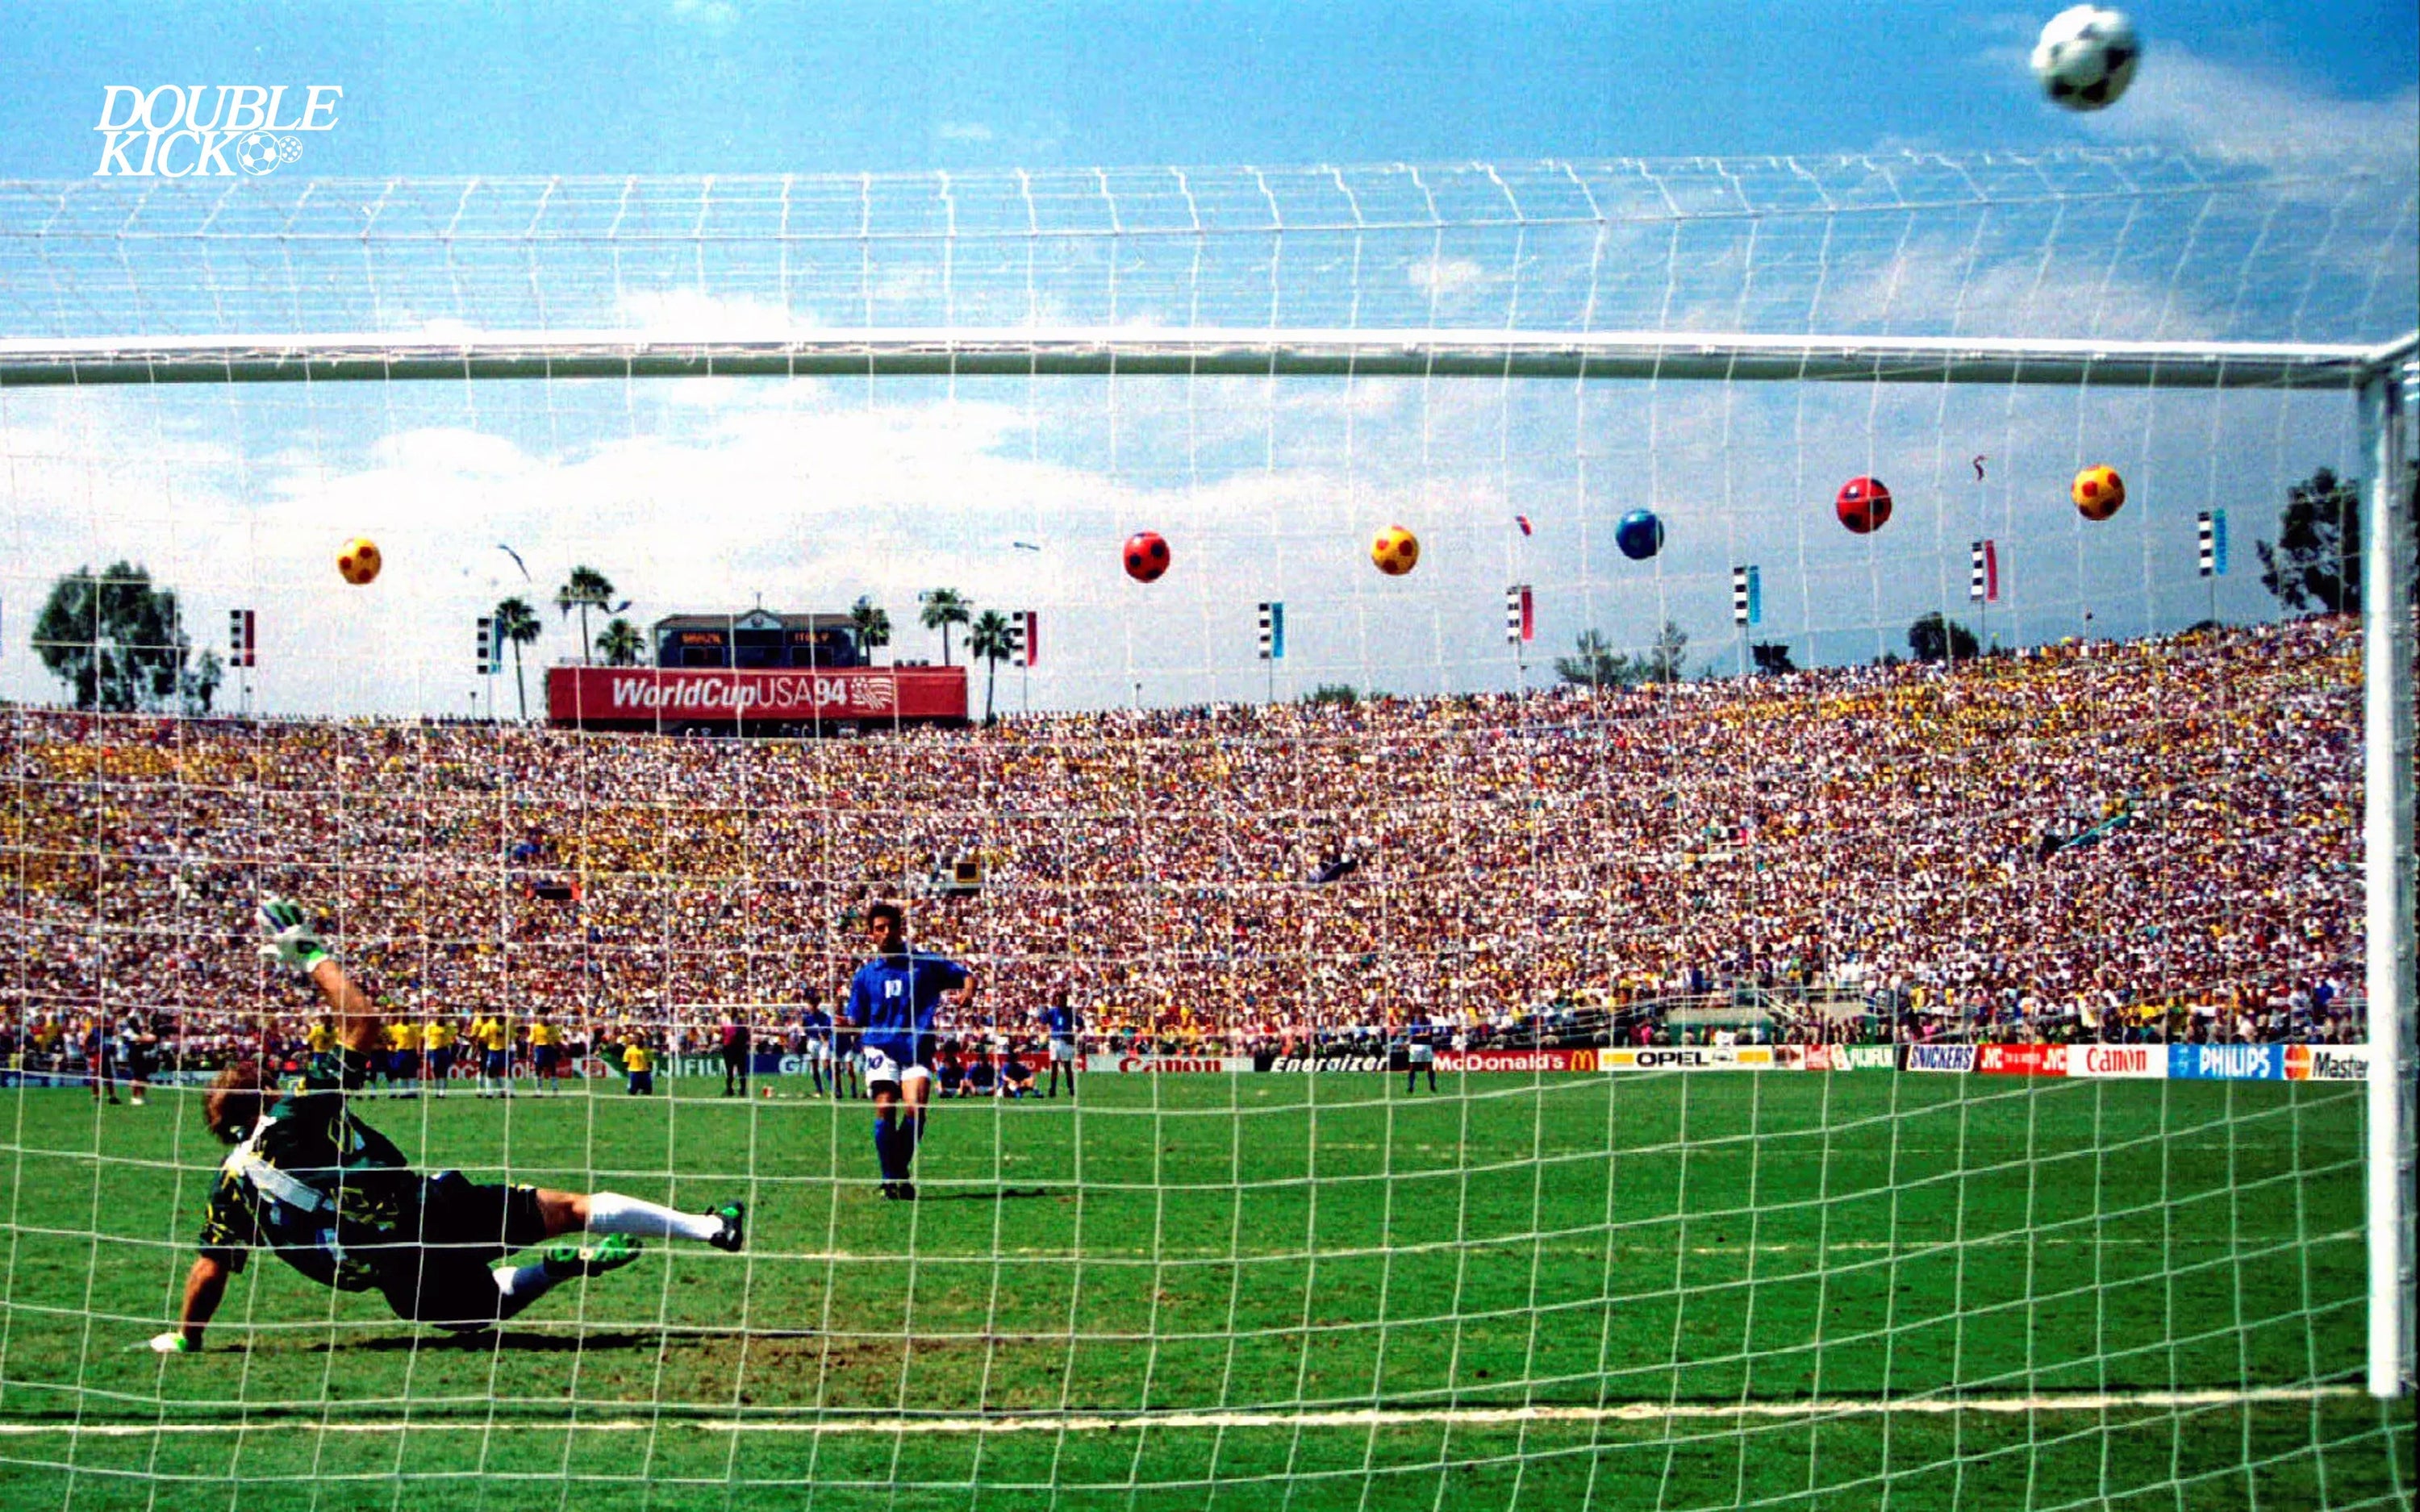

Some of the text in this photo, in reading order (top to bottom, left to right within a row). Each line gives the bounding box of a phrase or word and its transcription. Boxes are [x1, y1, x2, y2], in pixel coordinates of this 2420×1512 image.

[885, 980, 902, 998] 10
[1119, 1057, 1221, 1073] Canon
[1270, 1053, 1389, 1073] Energizer
[1433, 1051, 1565, 1072] McDonald's
[1636, 1052, 1711, 1068] OPEL
[1910, 1046, 1973, 1070] SNICKERS
[2086, 1047, 2147, 1073] Canon
[2199, 1048, 2270, 1078] PHILIPS
[2312, 1051, 2369, 1079] Master
